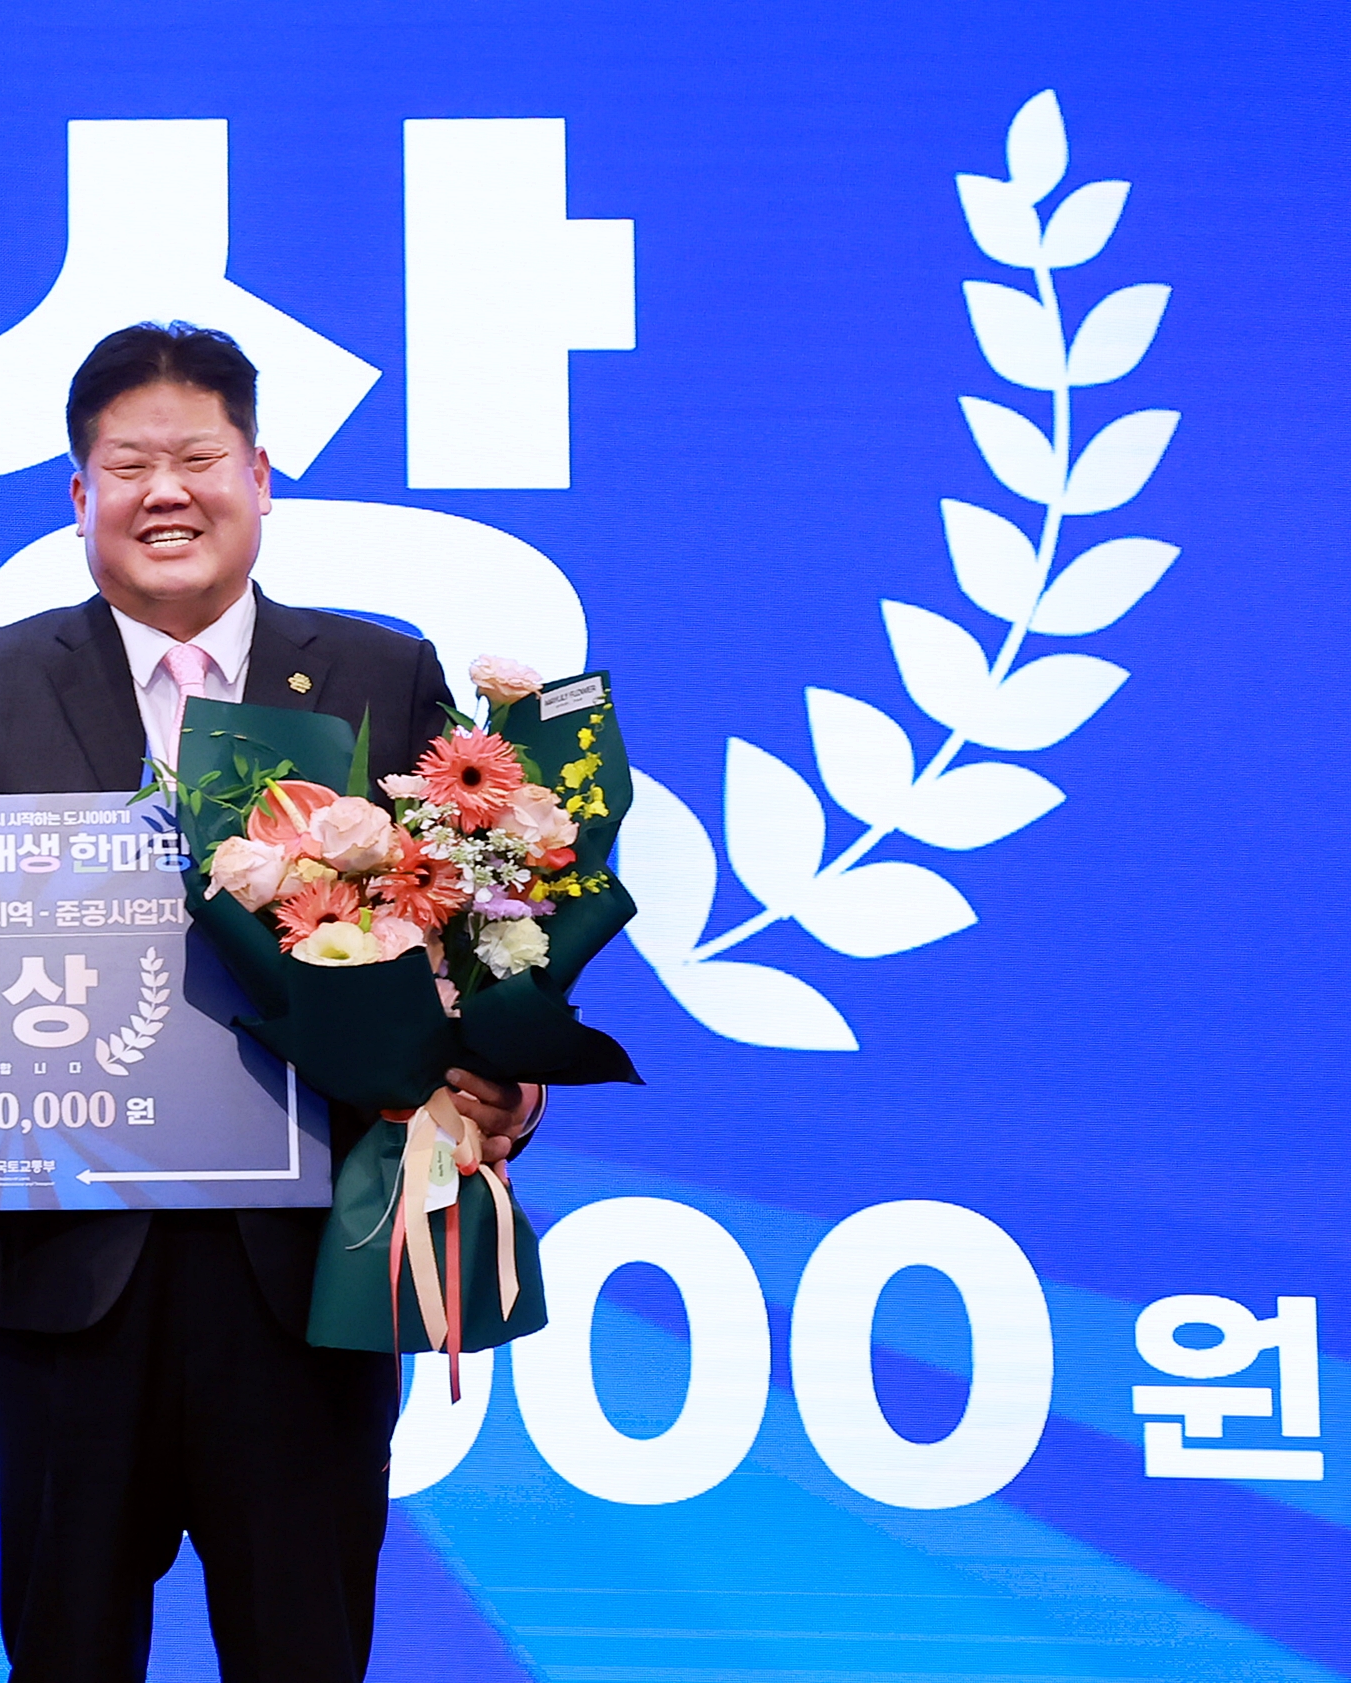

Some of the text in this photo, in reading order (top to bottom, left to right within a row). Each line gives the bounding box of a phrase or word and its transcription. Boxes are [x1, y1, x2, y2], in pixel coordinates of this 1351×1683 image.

[7, 810, 61, 826] 시작하는
[63, 809, 131, 825] 도시이야기
[55, 898, 185, 927] 준공사업지
[125, 1097, 156, 1126] 원
[1133, 1294, 1325, 1482] 원
